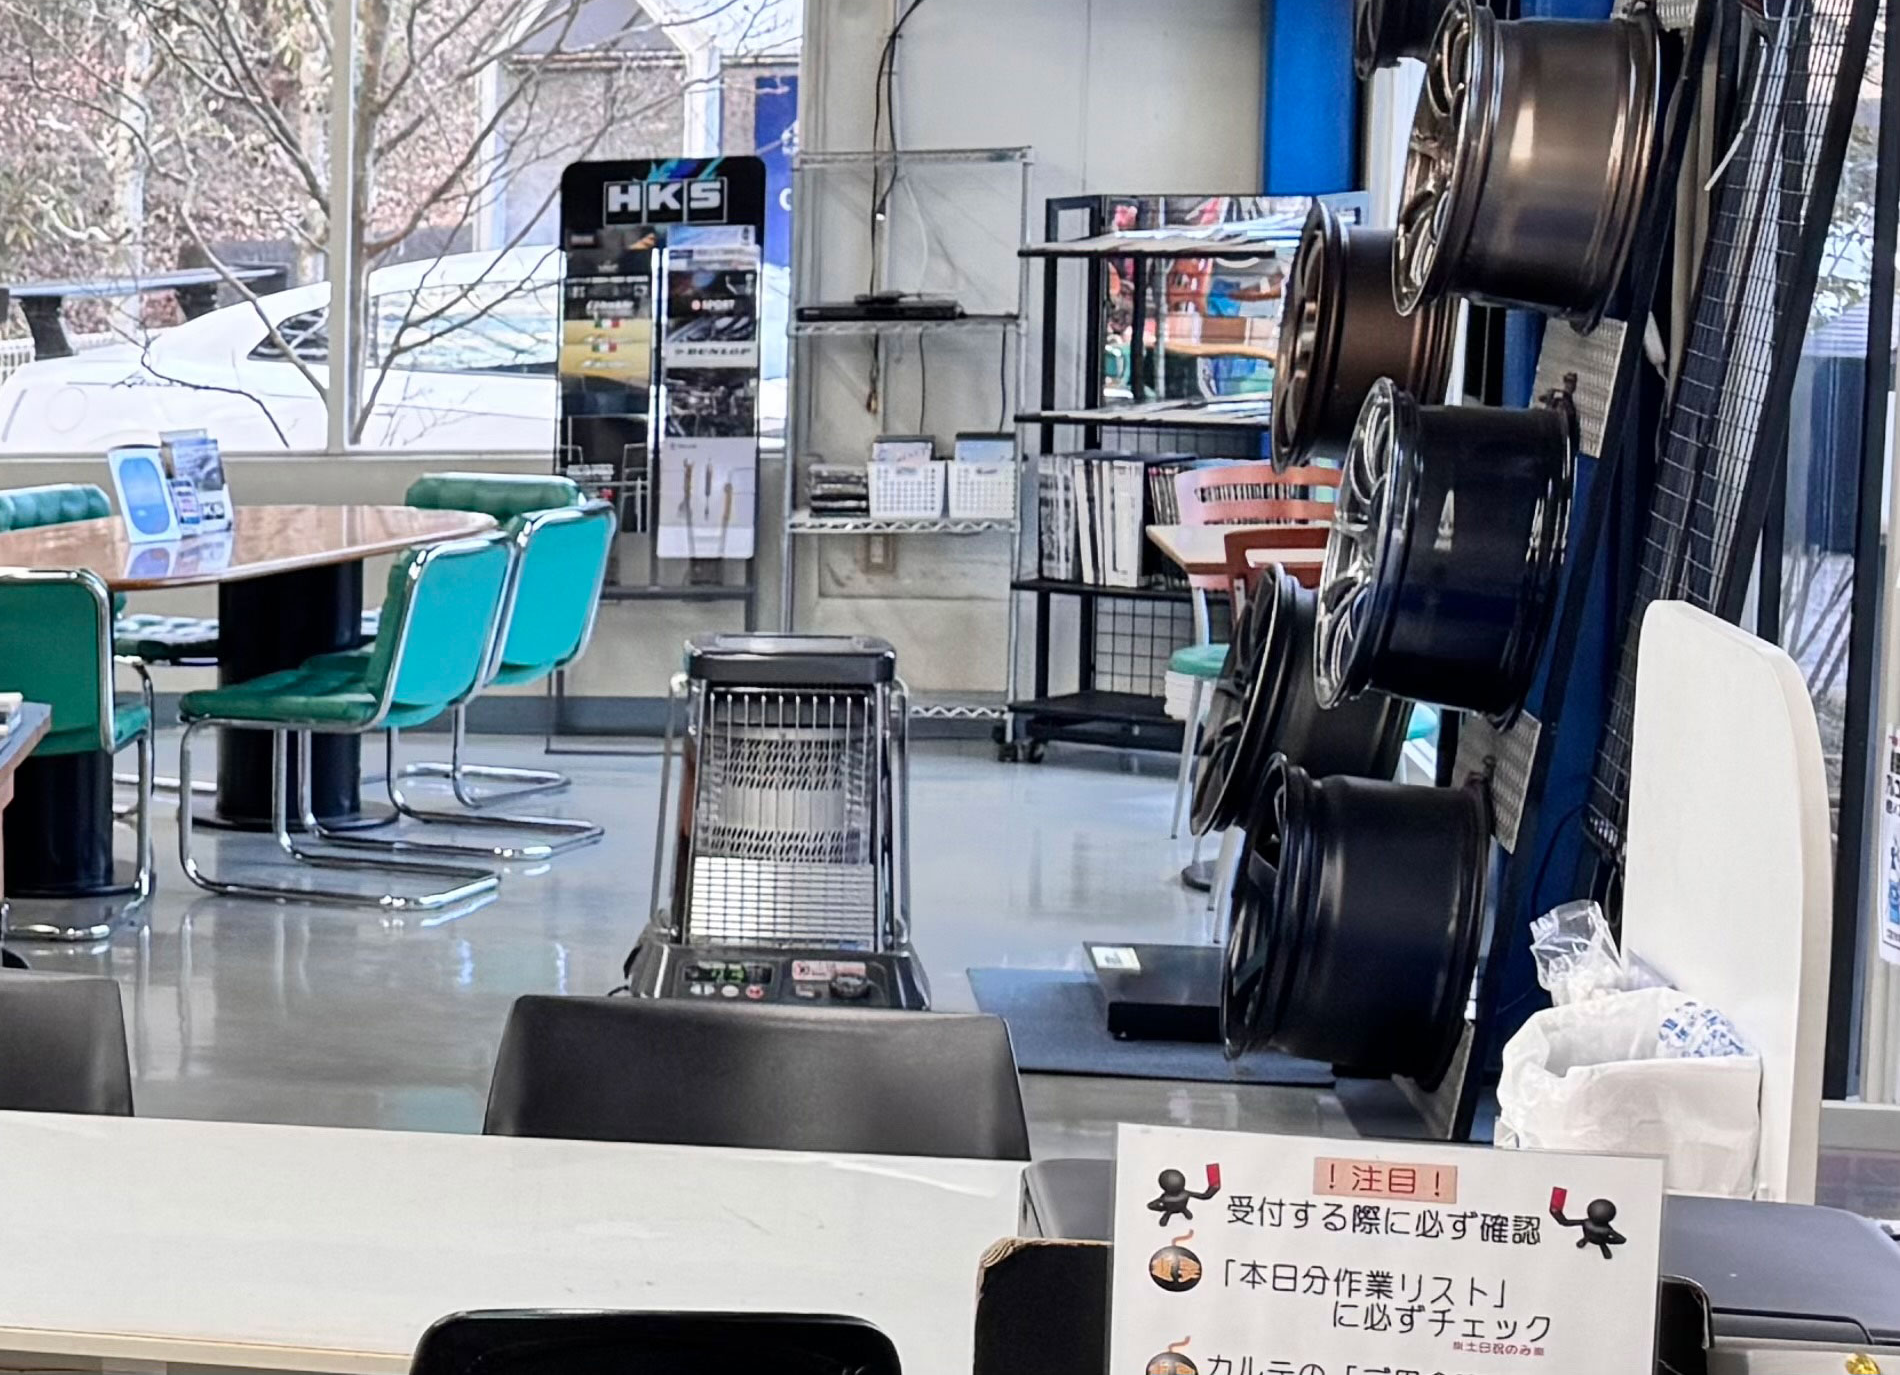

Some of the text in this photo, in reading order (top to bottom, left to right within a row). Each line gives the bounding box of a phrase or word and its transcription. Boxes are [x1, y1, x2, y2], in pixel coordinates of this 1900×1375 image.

[606, 181, 722, 213] HKS
[1226, 1194, 1542, 1246] 受付する際に必ず確認
[1223, 1257, 1508, 1310] 「本日分作業リスト」
[1333, 1299, 1552, 1344] に必ずチェック
